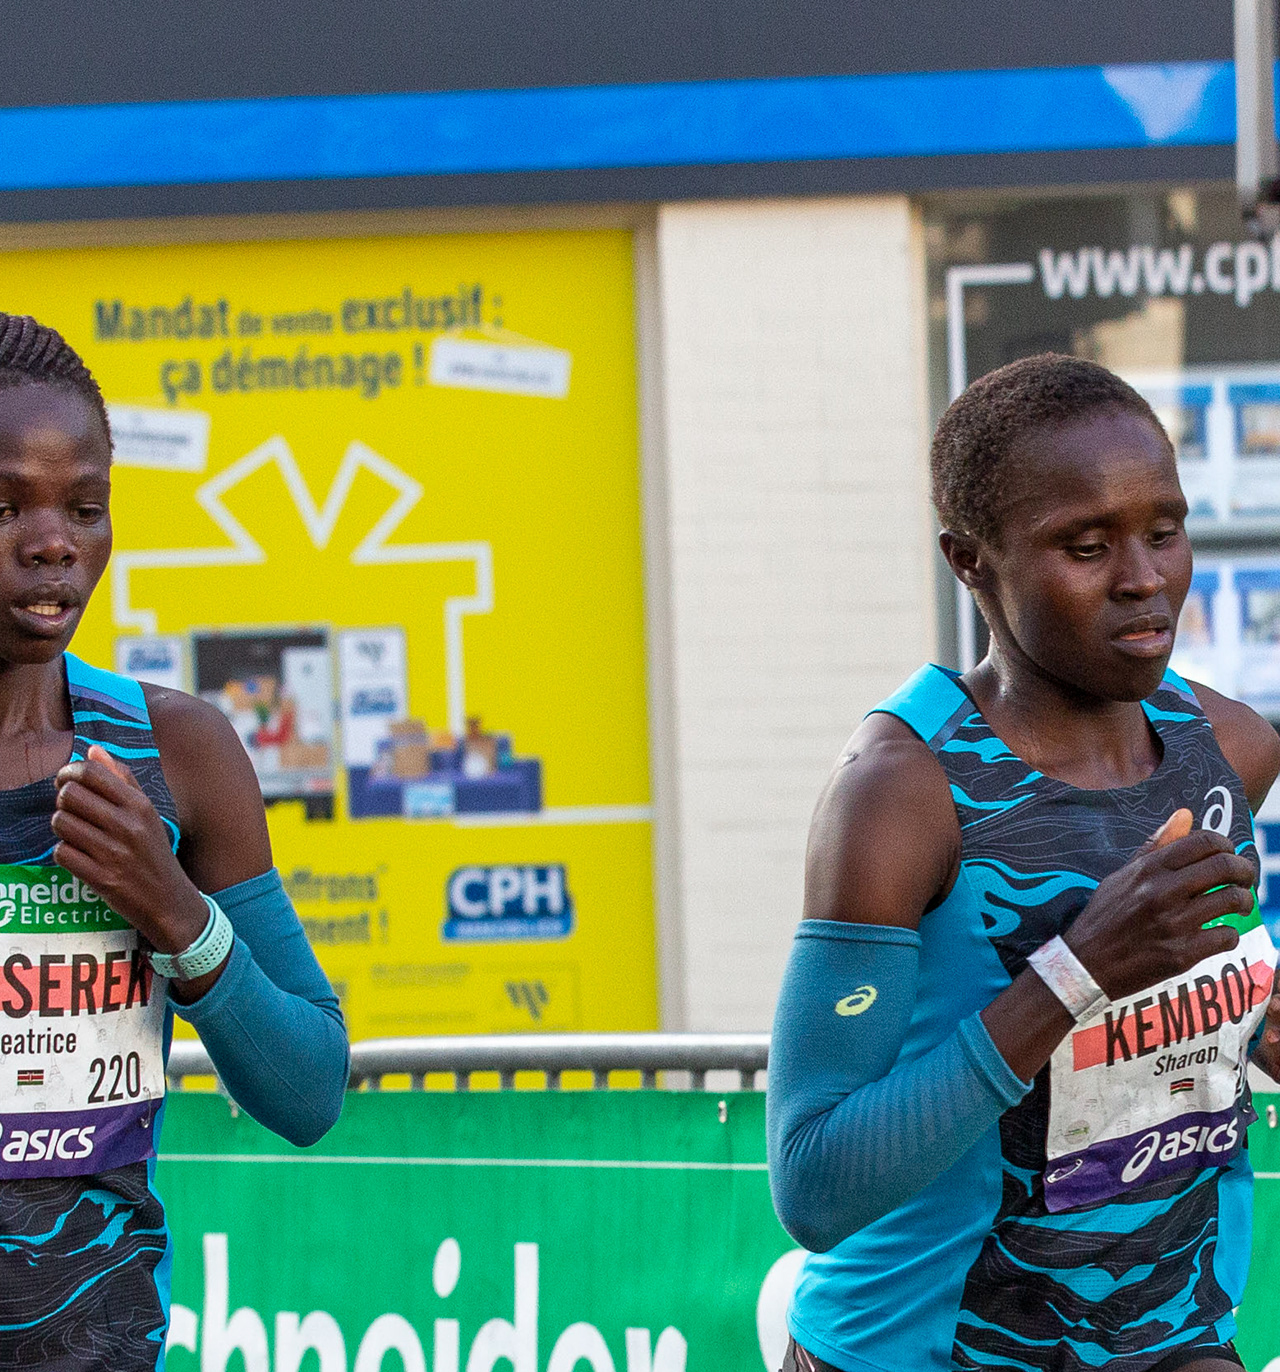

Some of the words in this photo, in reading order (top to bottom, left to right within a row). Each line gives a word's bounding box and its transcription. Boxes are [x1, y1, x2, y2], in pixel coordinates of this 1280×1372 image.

[94, 294, 229, 341] Mandat
[341, 284, 483, 334] exclusif
[160, 359, 201, 404] ça
[212, 345, 402, 398] déménage
[21, 906, 112, 924] Electric
[449, 866, 565, 918] CPH
[1104, 957, 1257, 1067] KEMBOI
[87, 1051, 141, 1104] 220
[1153, 1044, 1219, 1077] Sharon
